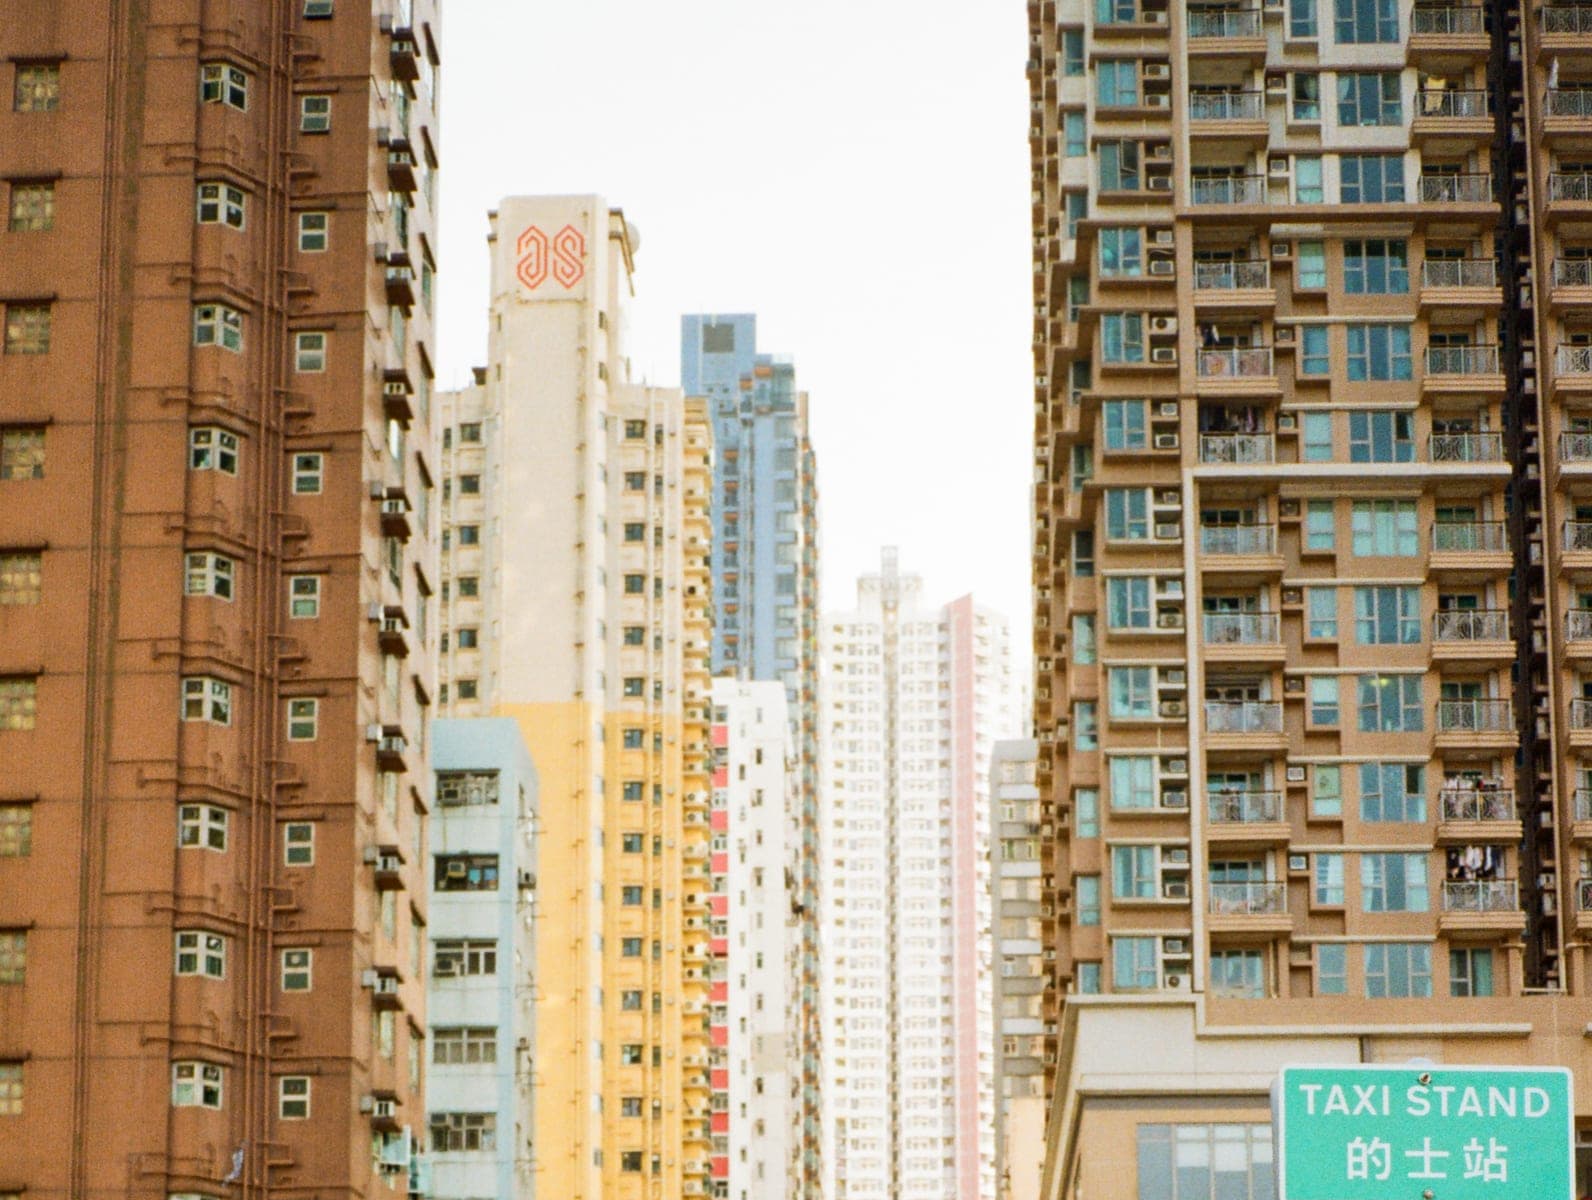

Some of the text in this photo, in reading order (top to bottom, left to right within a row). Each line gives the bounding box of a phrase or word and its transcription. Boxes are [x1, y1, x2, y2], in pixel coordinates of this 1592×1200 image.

[1299, 1084, 1551, 1119] TAXI STAND
[1346, 1136, 1509, 1183] 的士站
